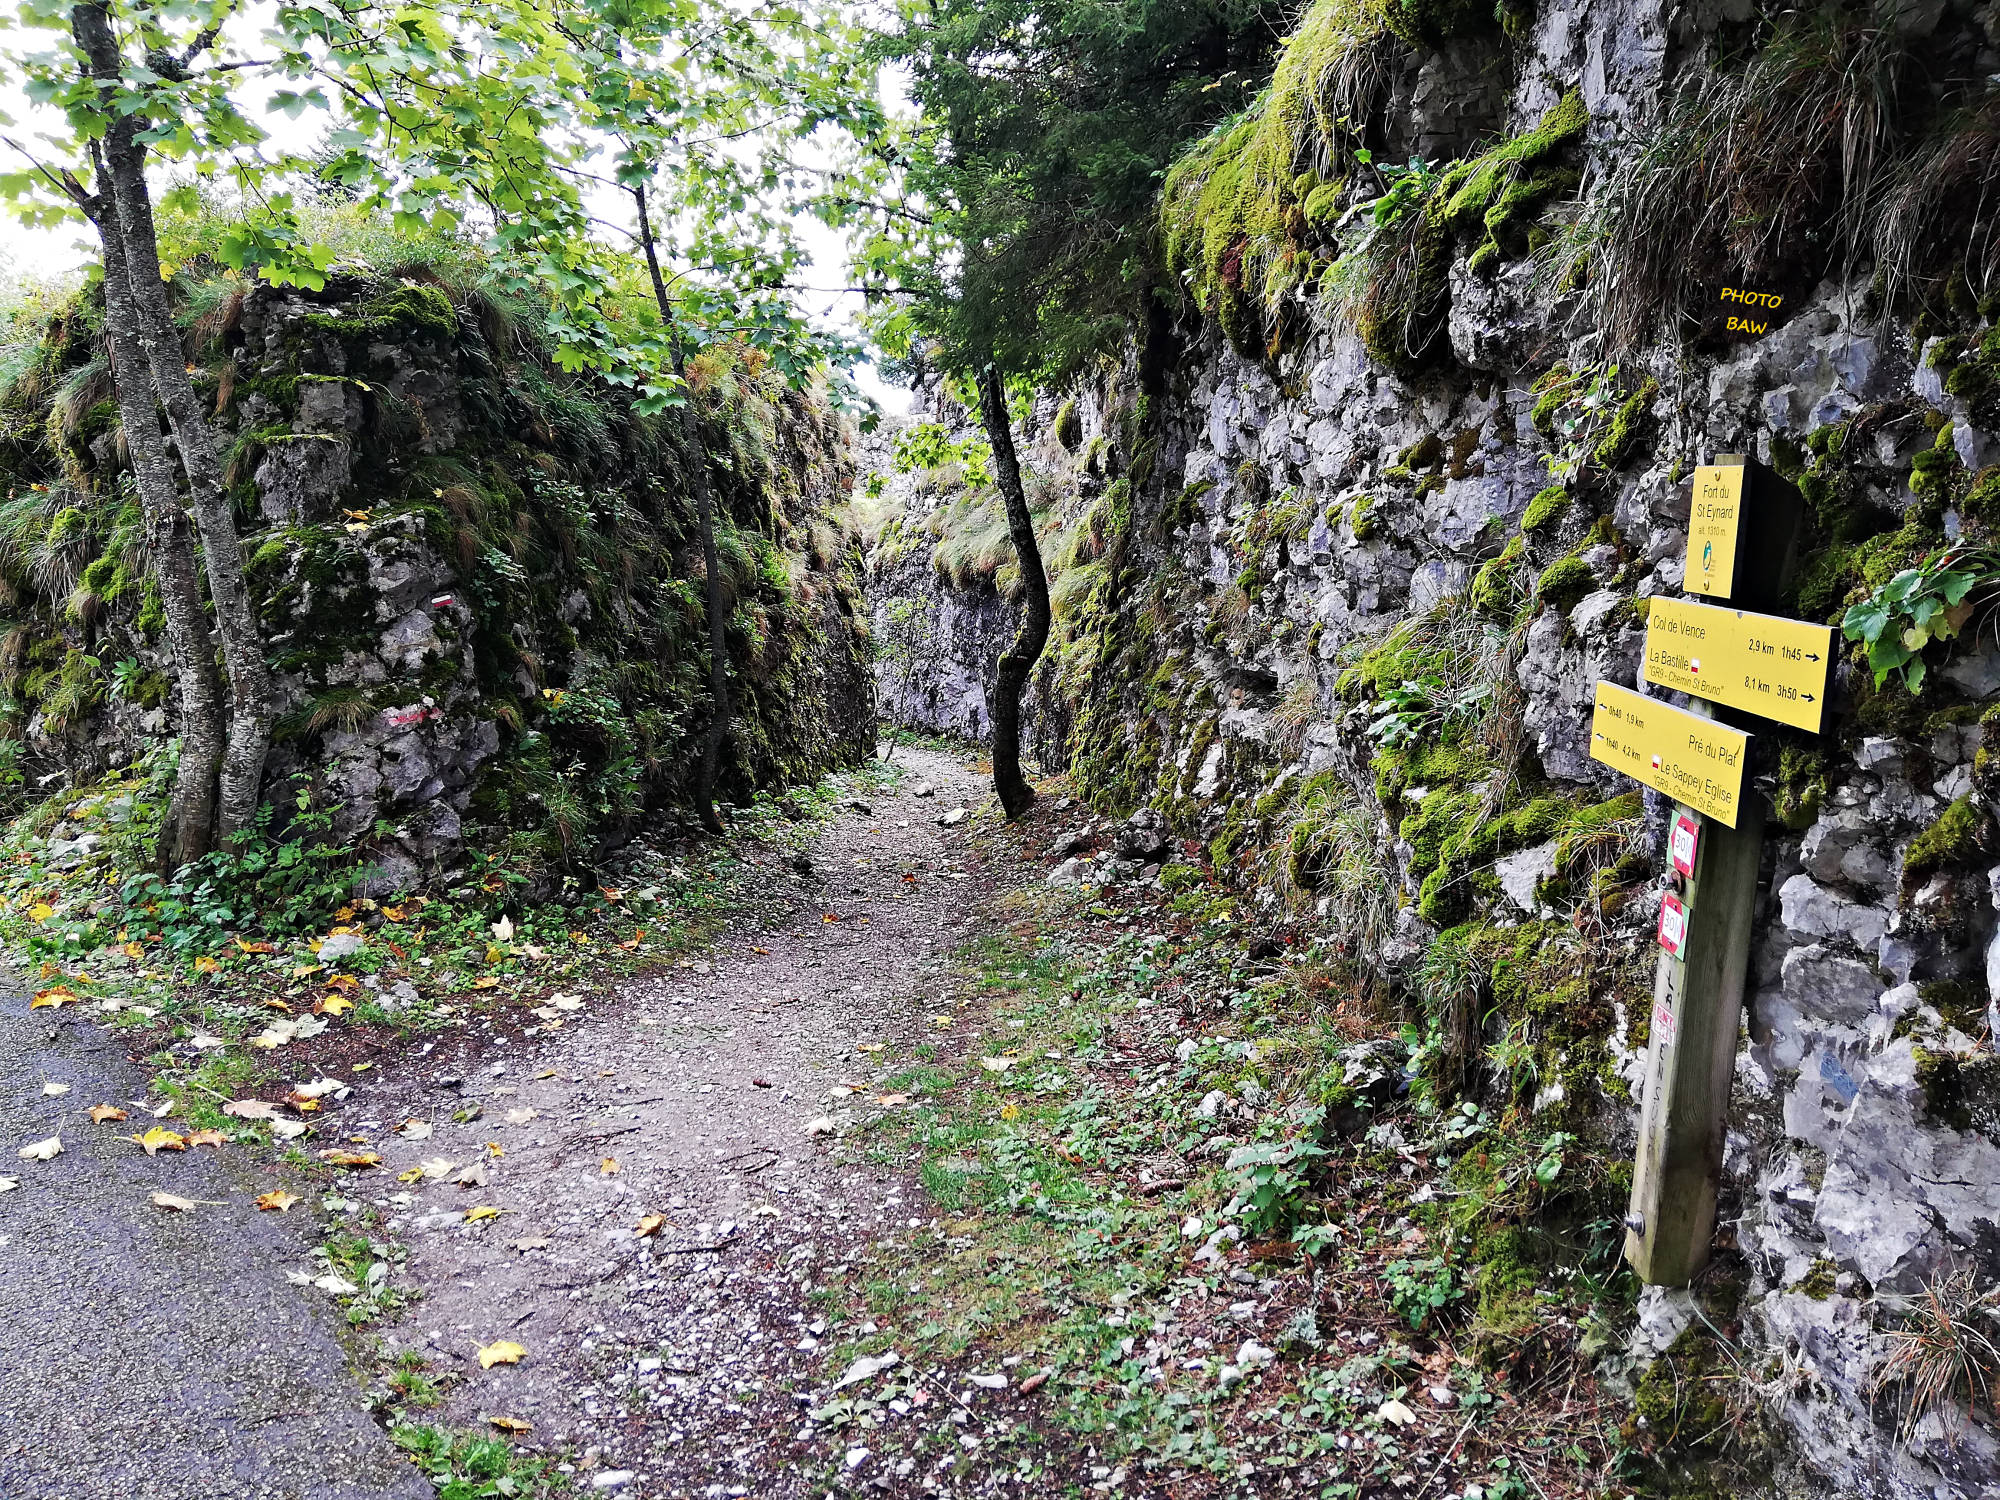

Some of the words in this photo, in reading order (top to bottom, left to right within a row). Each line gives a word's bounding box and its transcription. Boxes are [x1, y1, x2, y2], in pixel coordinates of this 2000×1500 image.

[1703, 484, 1718, 499] Fort
[1720, 484, 1730, 499] du
[1697, 503, 1705, 518] St
[1706, 504, 1734, 521] Eynard
[1653, 615, 1666, 631] Col
[1668, 619, 1677, 634] de
[1680, 620, 1705, 639] Vence
[1650, 648, 1659, 663] La
[1661, 650, 1689, 671] Bastille
[1748, 638, 1760, 653] 2,9
[1762, 641, 1774, 655] km
[1781, 645, 1801, 661] 1h45
[1668, 671, 1692, 687] Chemin
[1692, 678, 1700, 690] St
[1744, 675, 1756, 690] 8,1
[1758, 679, 1770, 694] km
[1777, 684, 1797, 701] 3h50
[1609, 705, 1621, 719] 0h40
[1626, 712, 1634, 725] 1,9
[1635, 716, 1644, 729] km
[1606, 737, 1618, 750] 1h40
[1632, 748, 1640, 761] km
[1688, 734, 1703, 754] Pré
[1705, 741, 1716, 759] du
[1718, 746, 1736, 768] Plat
[1660, 757, 1670, 775] Le
[1672, 764, 1703, 794] Sappey
[1705, 778, 1732, 804] Eglise
[1672, 785, 1696, 803] Chemin
[1697, 797, 1705, 809] St
